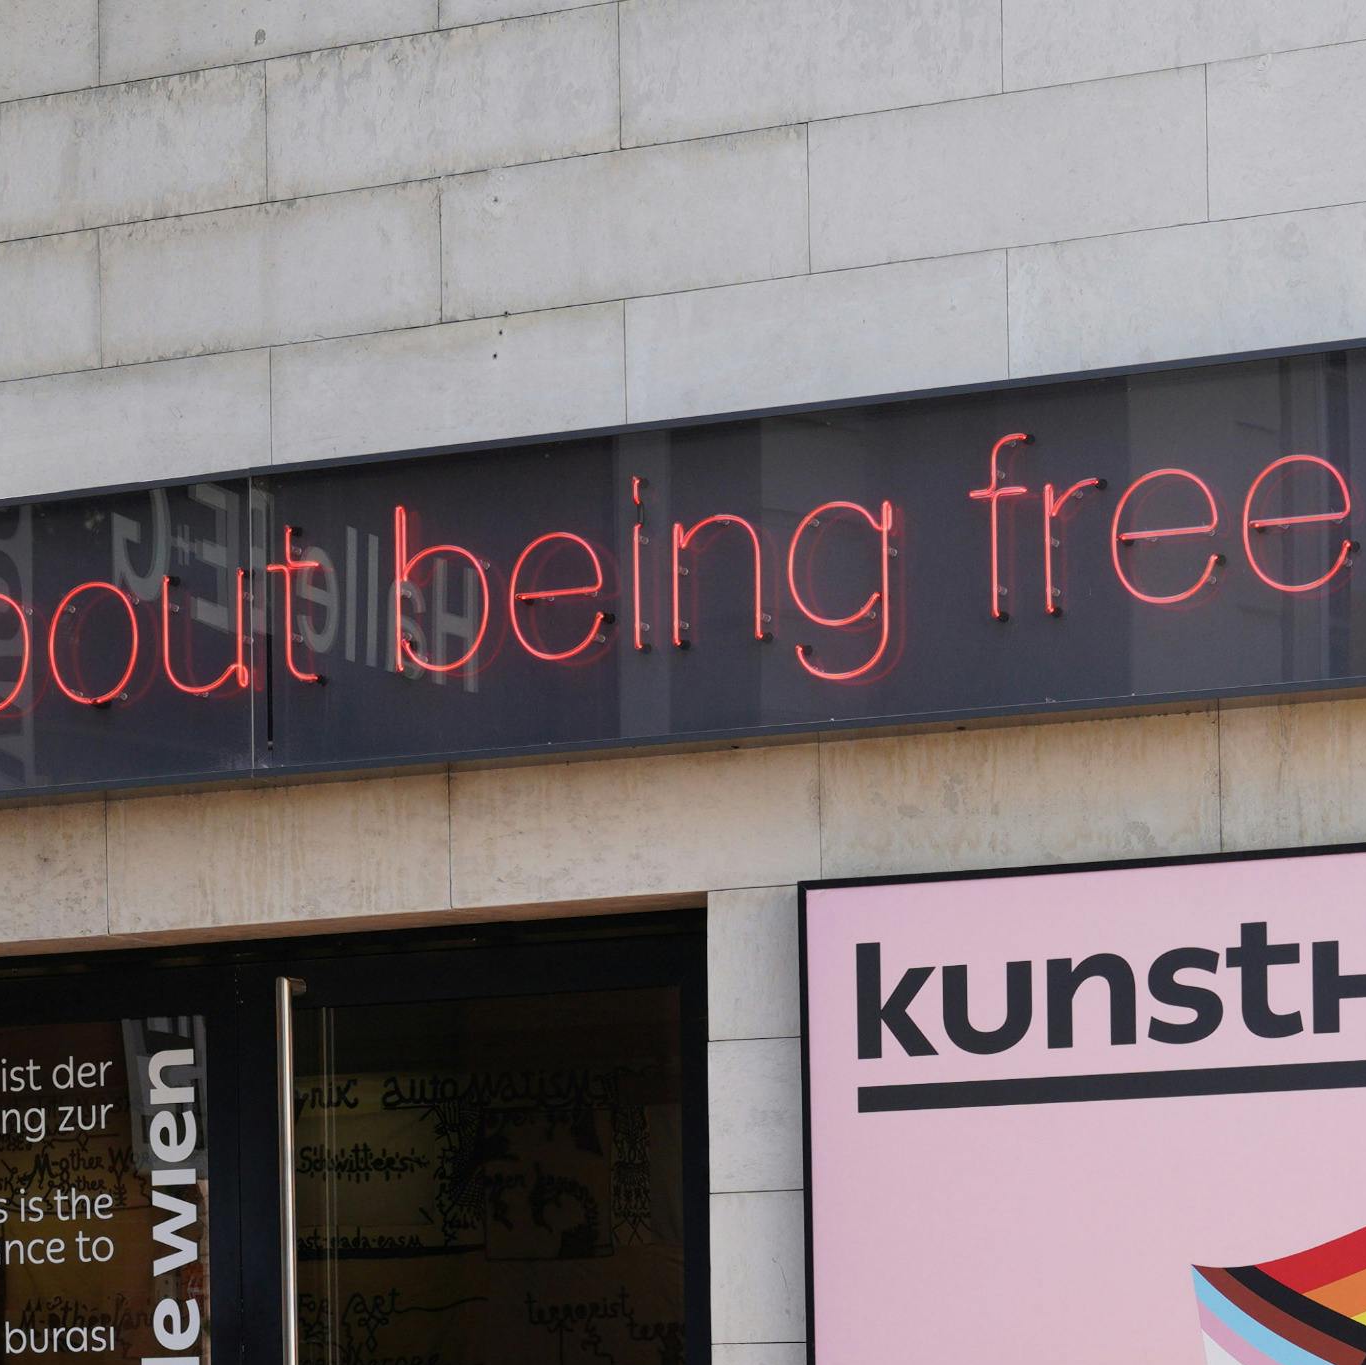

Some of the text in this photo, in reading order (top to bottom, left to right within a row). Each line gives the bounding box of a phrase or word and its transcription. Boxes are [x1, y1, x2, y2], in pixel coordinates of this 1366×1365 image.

[395, 480, 892, 680] being
[971, 434, 1351, 616] free
[1, 1058, 42, 1092] ist
[52, 1055, 113, 1090] der
[58, 1103, 114, 1132] zur
[19, 1188, 44, 1223] is
[54, 1187, 114, 1222] the
[74, 1230, 114, 1263] to
[5, 1321, 115, 1354] burası
